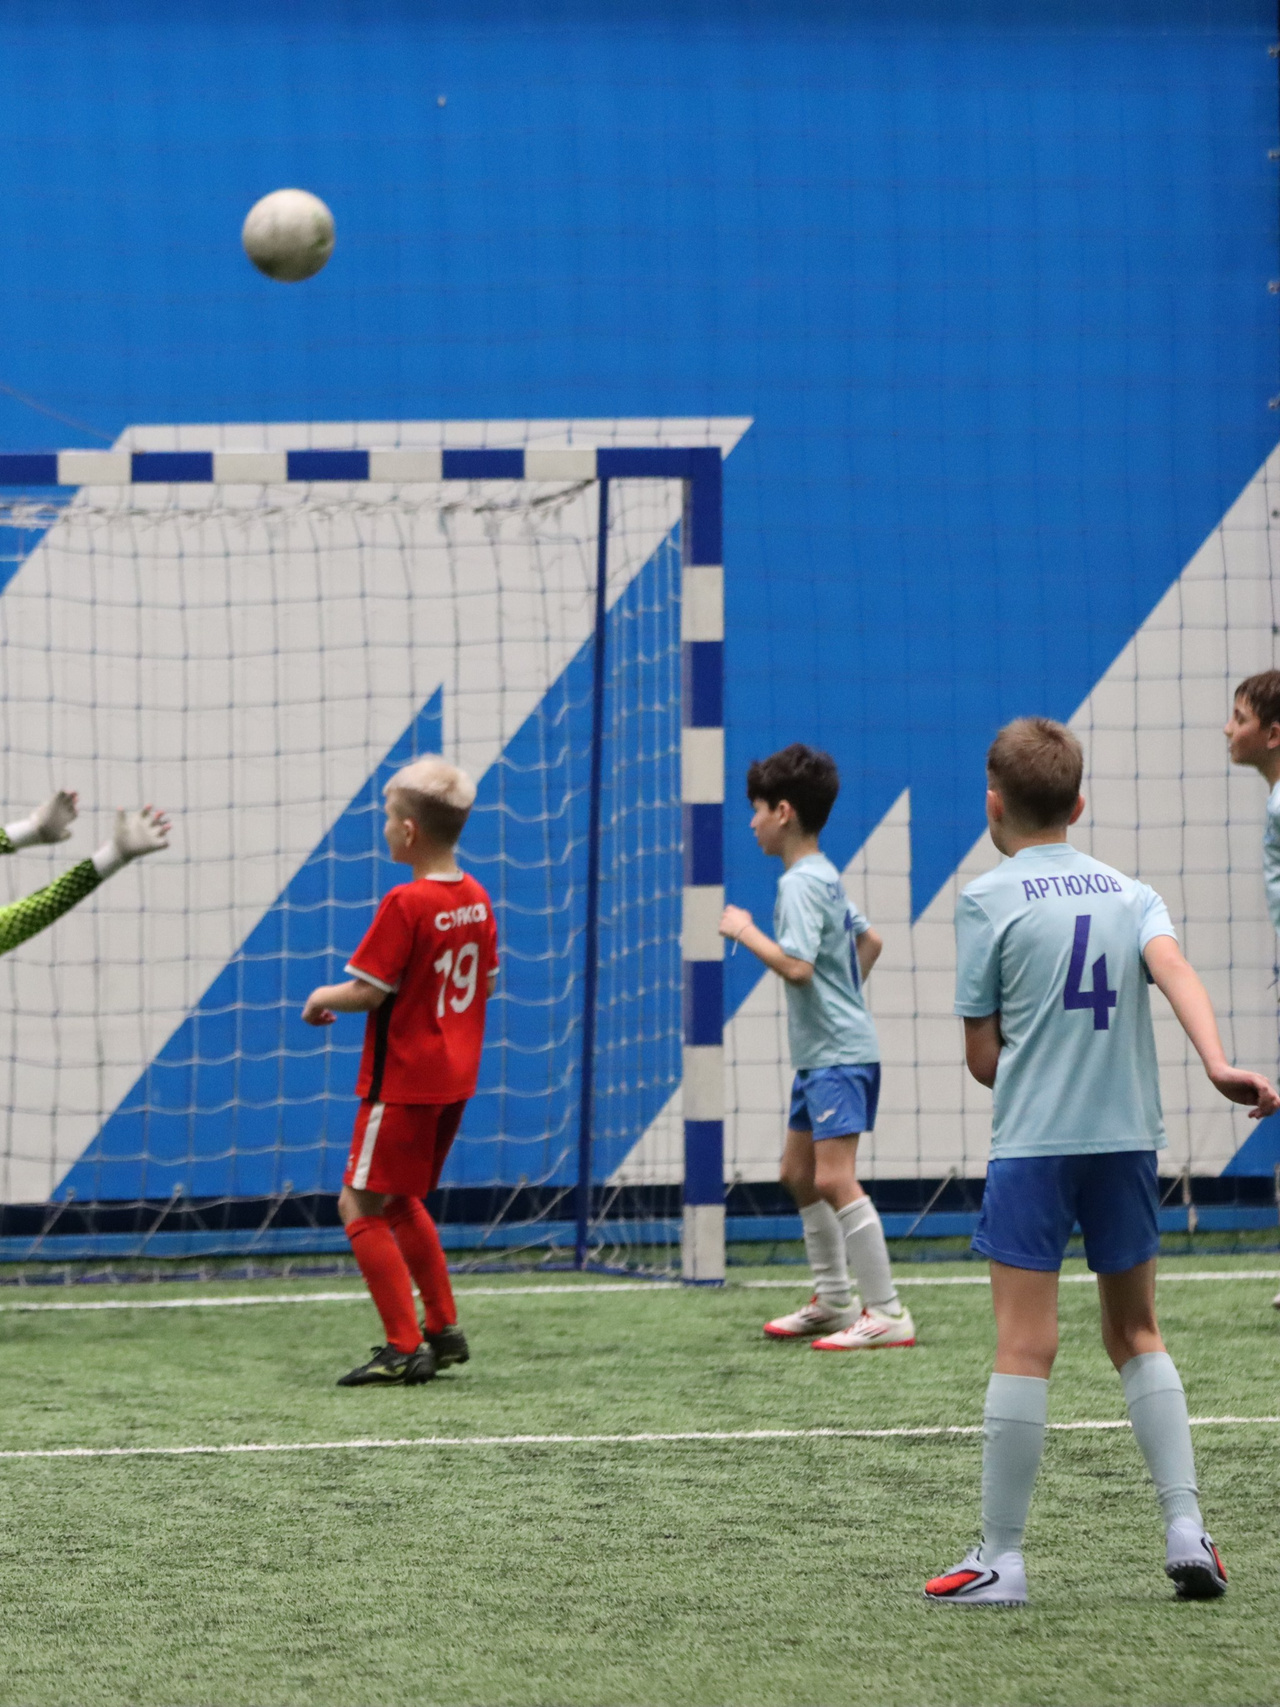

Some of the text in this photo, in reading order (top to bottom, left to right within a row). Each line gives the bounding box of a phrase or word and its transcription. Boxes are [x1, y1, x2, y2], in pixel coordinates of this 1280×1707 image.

[1021, 873, 1122, 901] АРТЮХОВ
[433, 942, 479, 1018] 19
[1063, 914, 1117, 1031] 4
